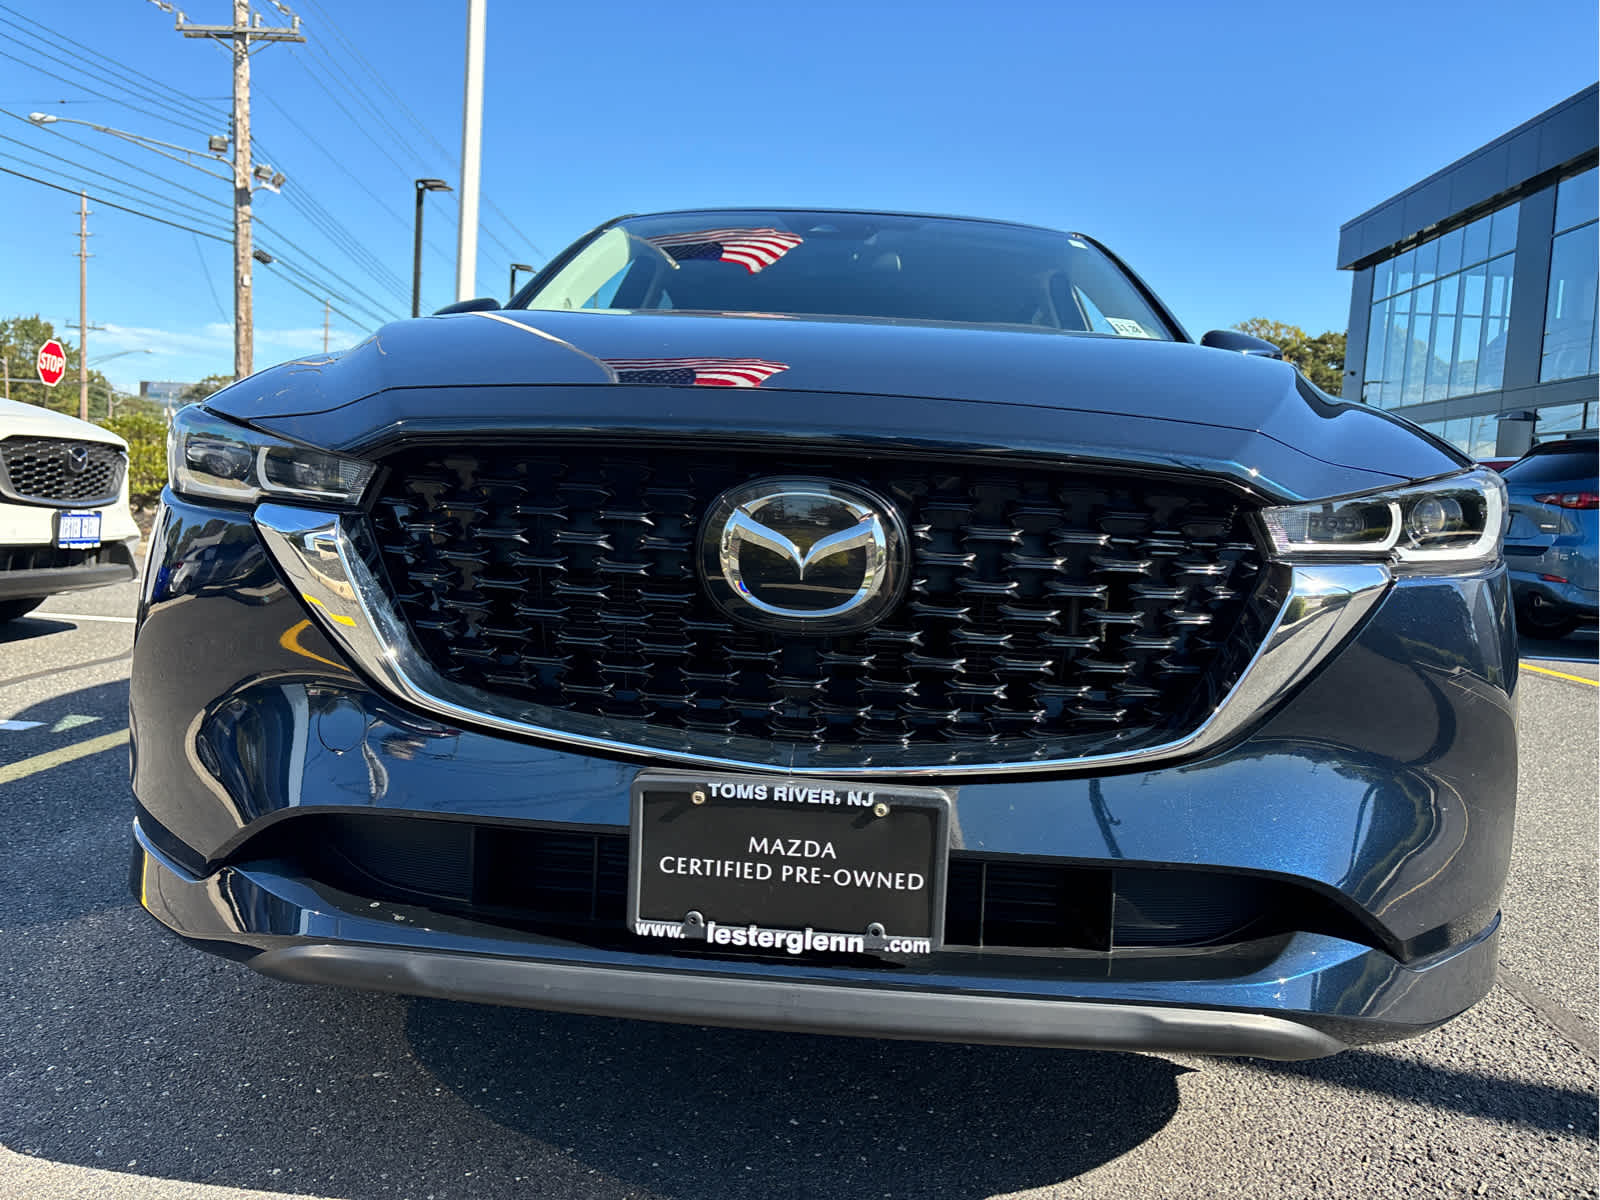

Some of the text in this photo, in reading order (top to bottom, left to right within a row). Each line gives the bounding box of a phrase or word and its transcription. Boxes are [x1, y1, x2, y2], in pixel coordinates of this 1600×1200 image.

[40, 352, 63, 373] STOP
[708, 782, 874, 807] TOMS RIVER, NJ
[748, 836, 836, 859] MAZDA
[659, 856, 924, 890] CERTIFIED PRE-OWNED
[635, 921, 930, 954] www. lesterglenn .com
